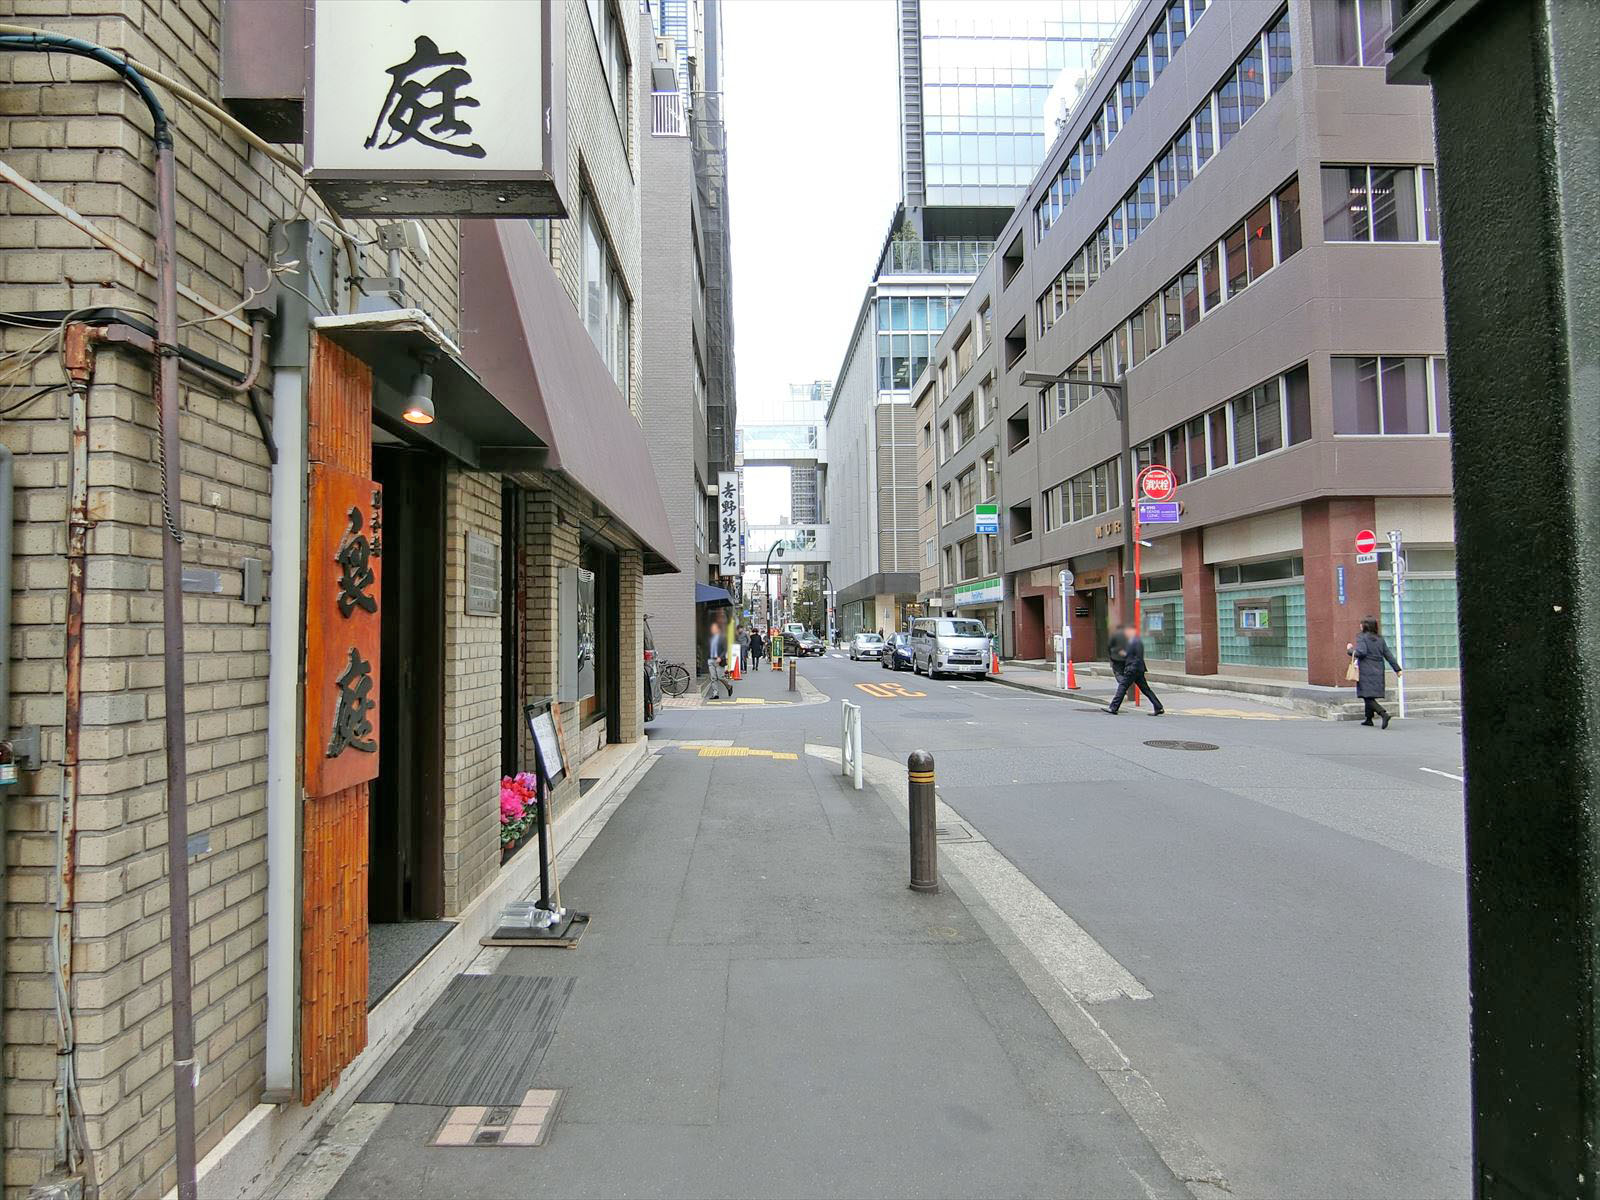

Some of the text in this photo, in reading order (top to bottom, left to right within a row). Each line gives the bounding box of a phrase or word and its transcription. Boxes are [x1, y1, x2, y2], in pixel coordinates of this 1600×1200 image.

[1145, 479, 1169, 491] 消火栓
[721, 481, 737, 567] 吉野鮨本店
